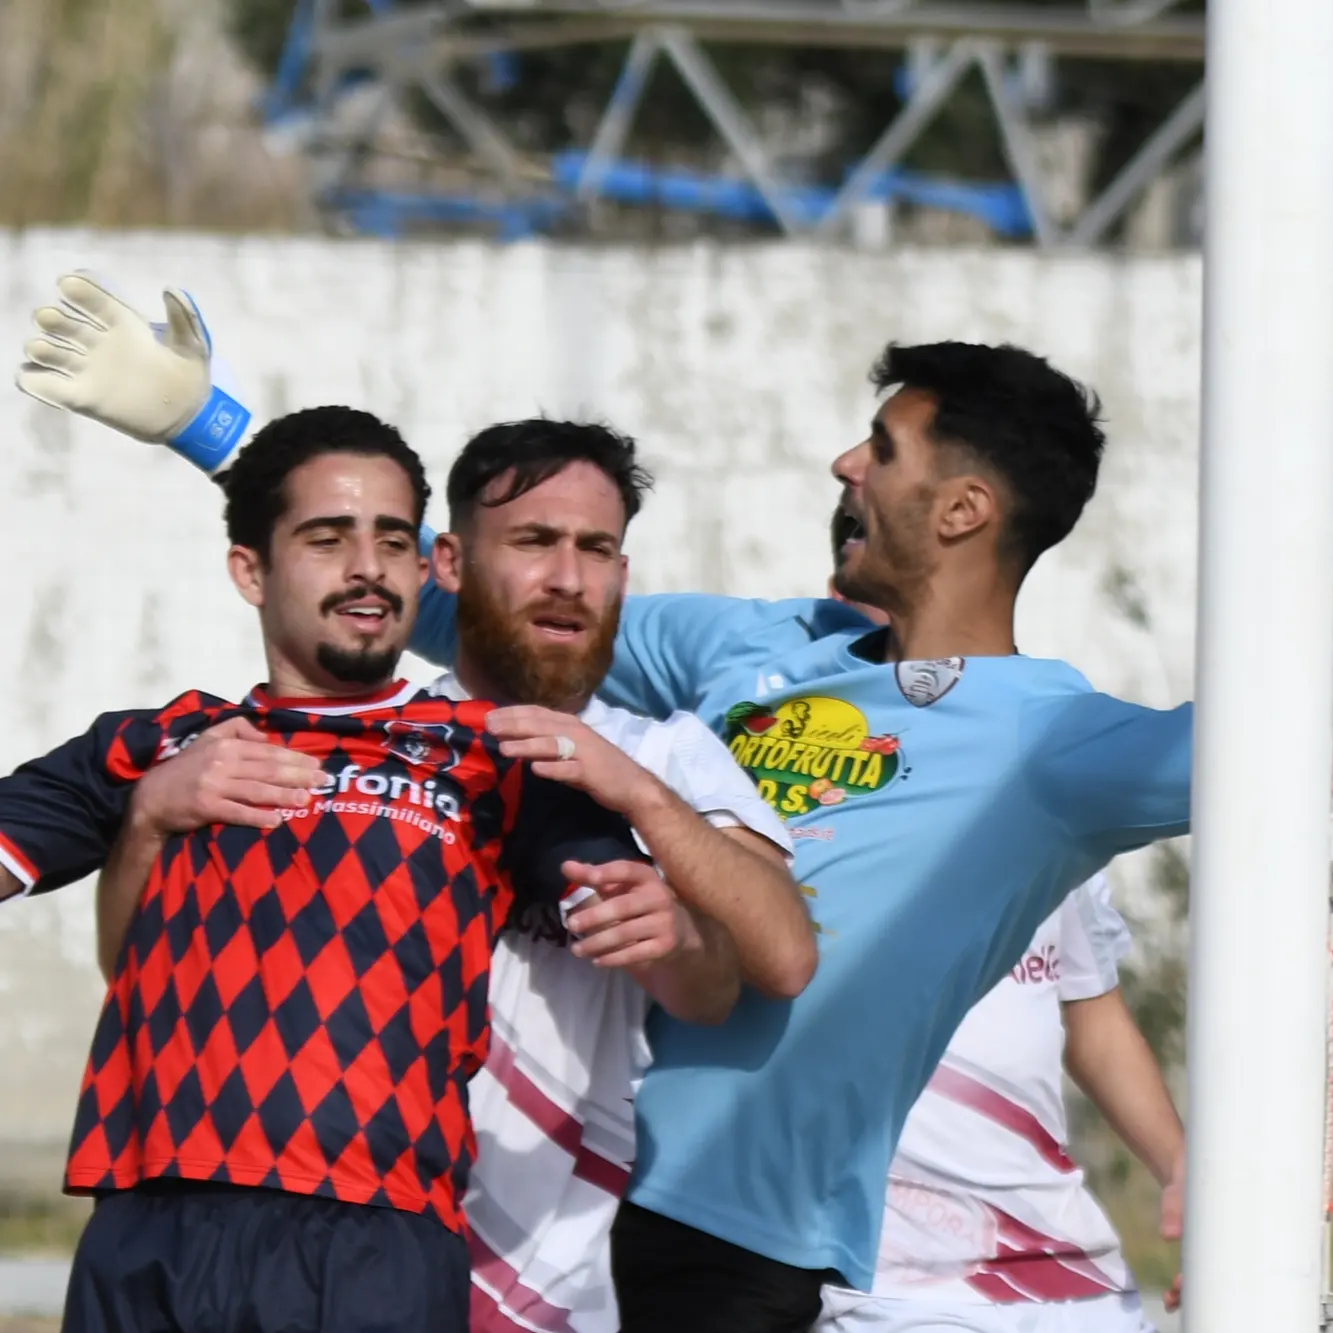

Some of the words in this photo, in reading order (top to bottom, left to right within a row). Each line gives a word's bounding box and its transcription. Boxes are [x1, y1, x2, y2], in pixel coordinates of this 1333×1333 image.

[729, 734, 884, 789] ORTOFRUTTA
[309, 764, 462, 822] efonia
[313, 798, 457, 845] Massimiliano
